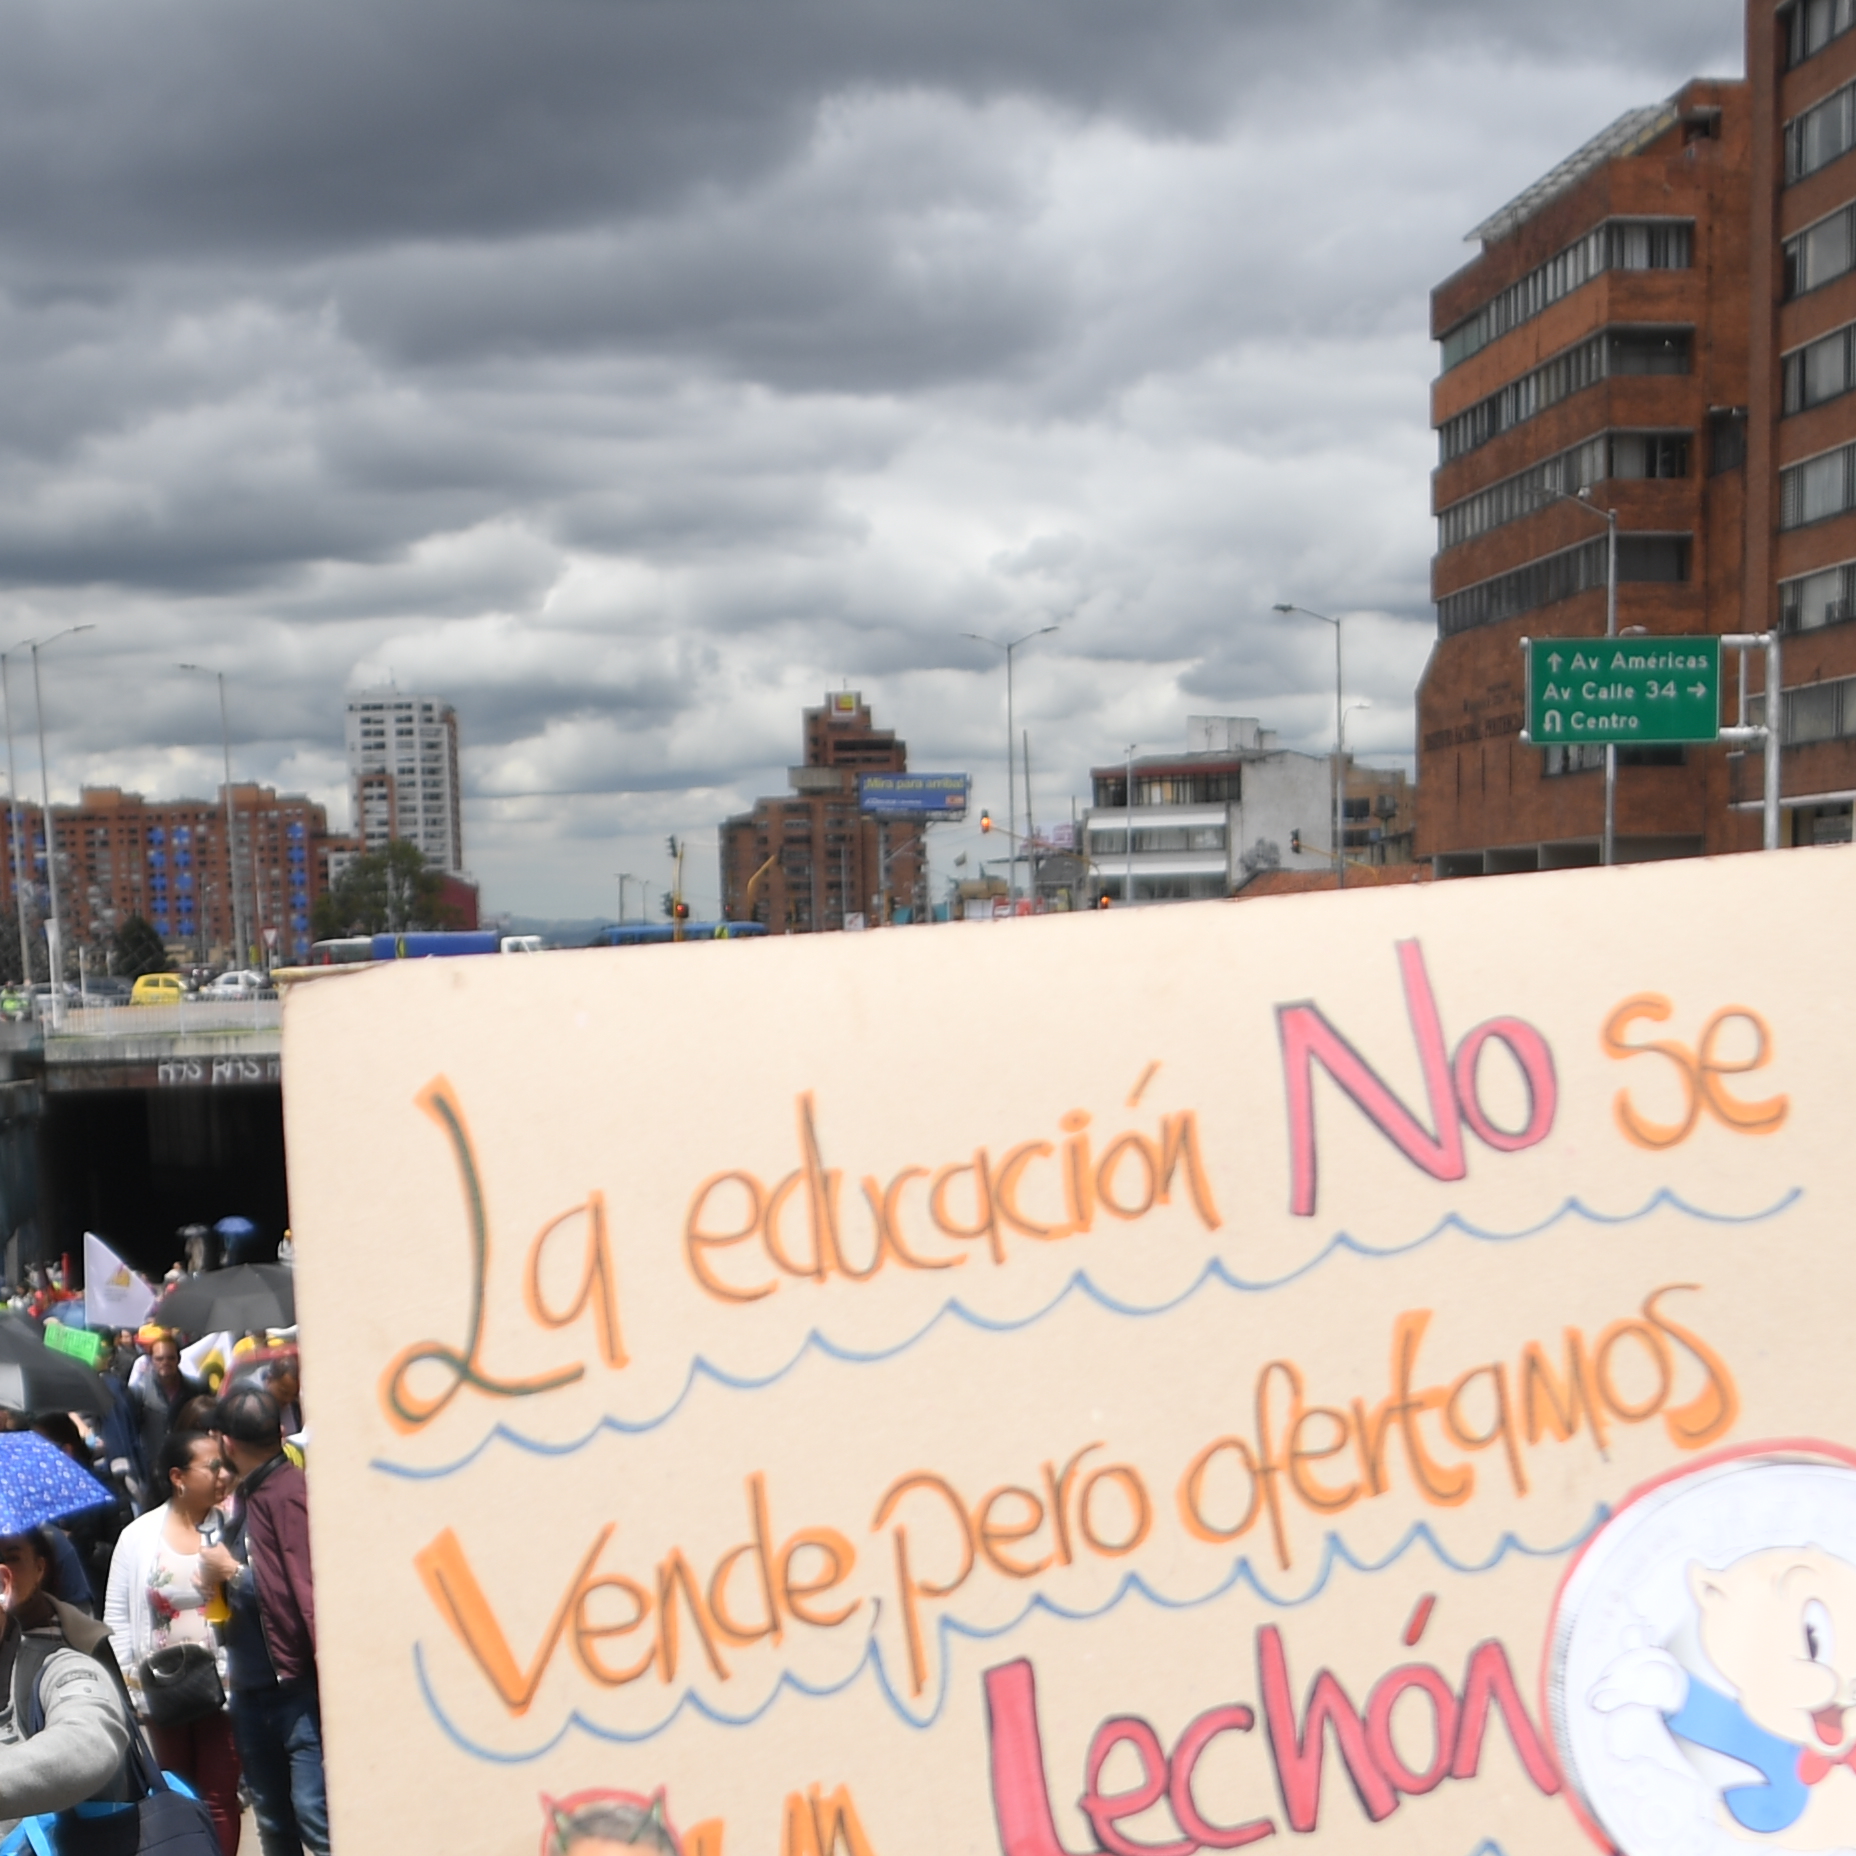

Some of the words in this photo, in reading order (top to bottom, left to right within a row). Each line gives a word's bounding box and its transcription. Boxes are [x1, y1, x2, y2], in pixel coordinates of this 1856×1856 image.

[1570, 651, 1599, 670] Av
[1610, 651, 1709, 669] Américas
[1543, 682, 1571, 700] Av
[1582, 681, 1636, 700] Calle
[1645, 680, 1677, 699] 34
[1570, 711, 1639, 729] Centro
[377, 1072, 631, 1437] La
[682, 1060, 1222, 1305] educación
[1273, 936, 1556, 1217] No
[1177, 1283, 1739, 1572] ofertamos
